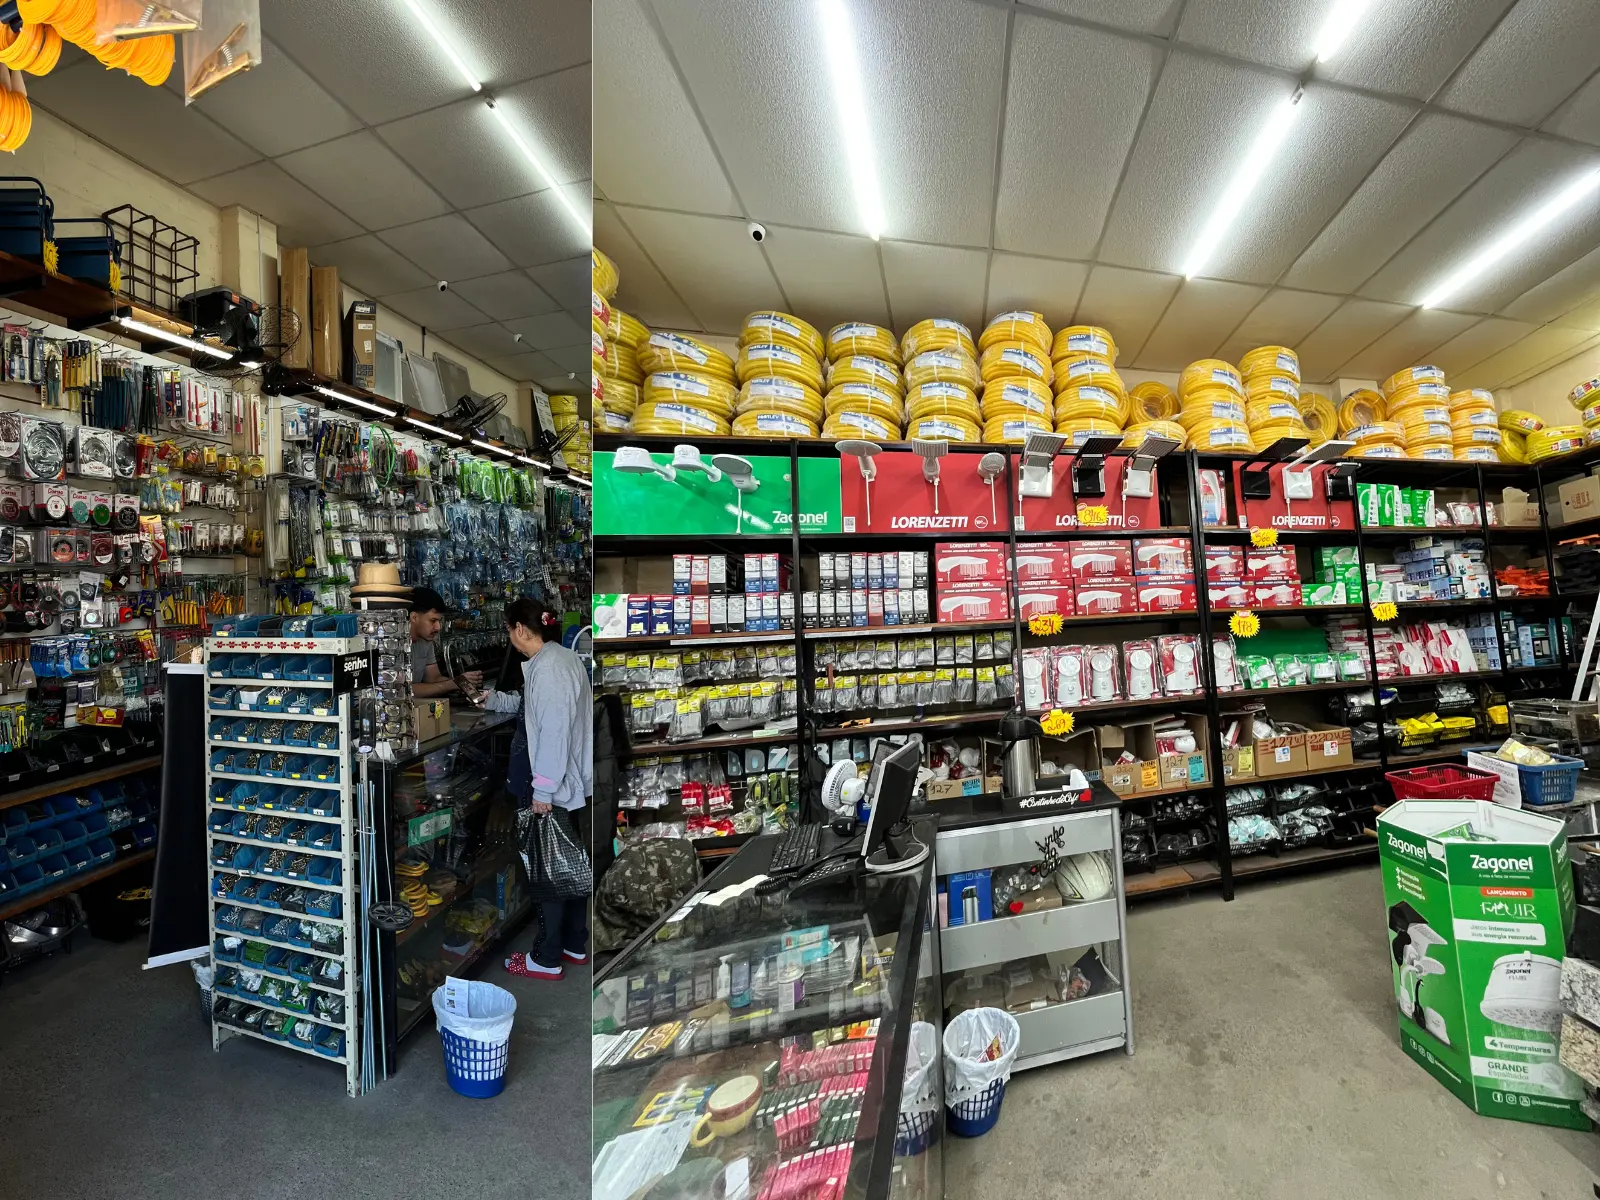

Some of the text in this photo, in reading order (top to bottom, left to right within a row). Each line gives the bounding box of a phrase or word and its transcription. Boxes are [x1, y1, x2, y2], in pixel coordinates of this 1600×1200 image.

[772, 510, 828, 524] Zaonel
[891, 516, 968, 529] LORENZETTI
[1056, 515, 1123, 526] LORTTI
[1272, 515, 1326, 526] LORENZETTI
[344, 657, 368, 672] senha
[930, 784, 953, 794] 127
[1387, 832, 1427, 860] Zagonel
[1470, 854, 1533, 874] Zagonel
[1480, 901, 1537, 918] FLUIR
[1499, 1042, 1552, 1054] Temperaturas
[1487, 1061, 1529, 1074] GRANDE
